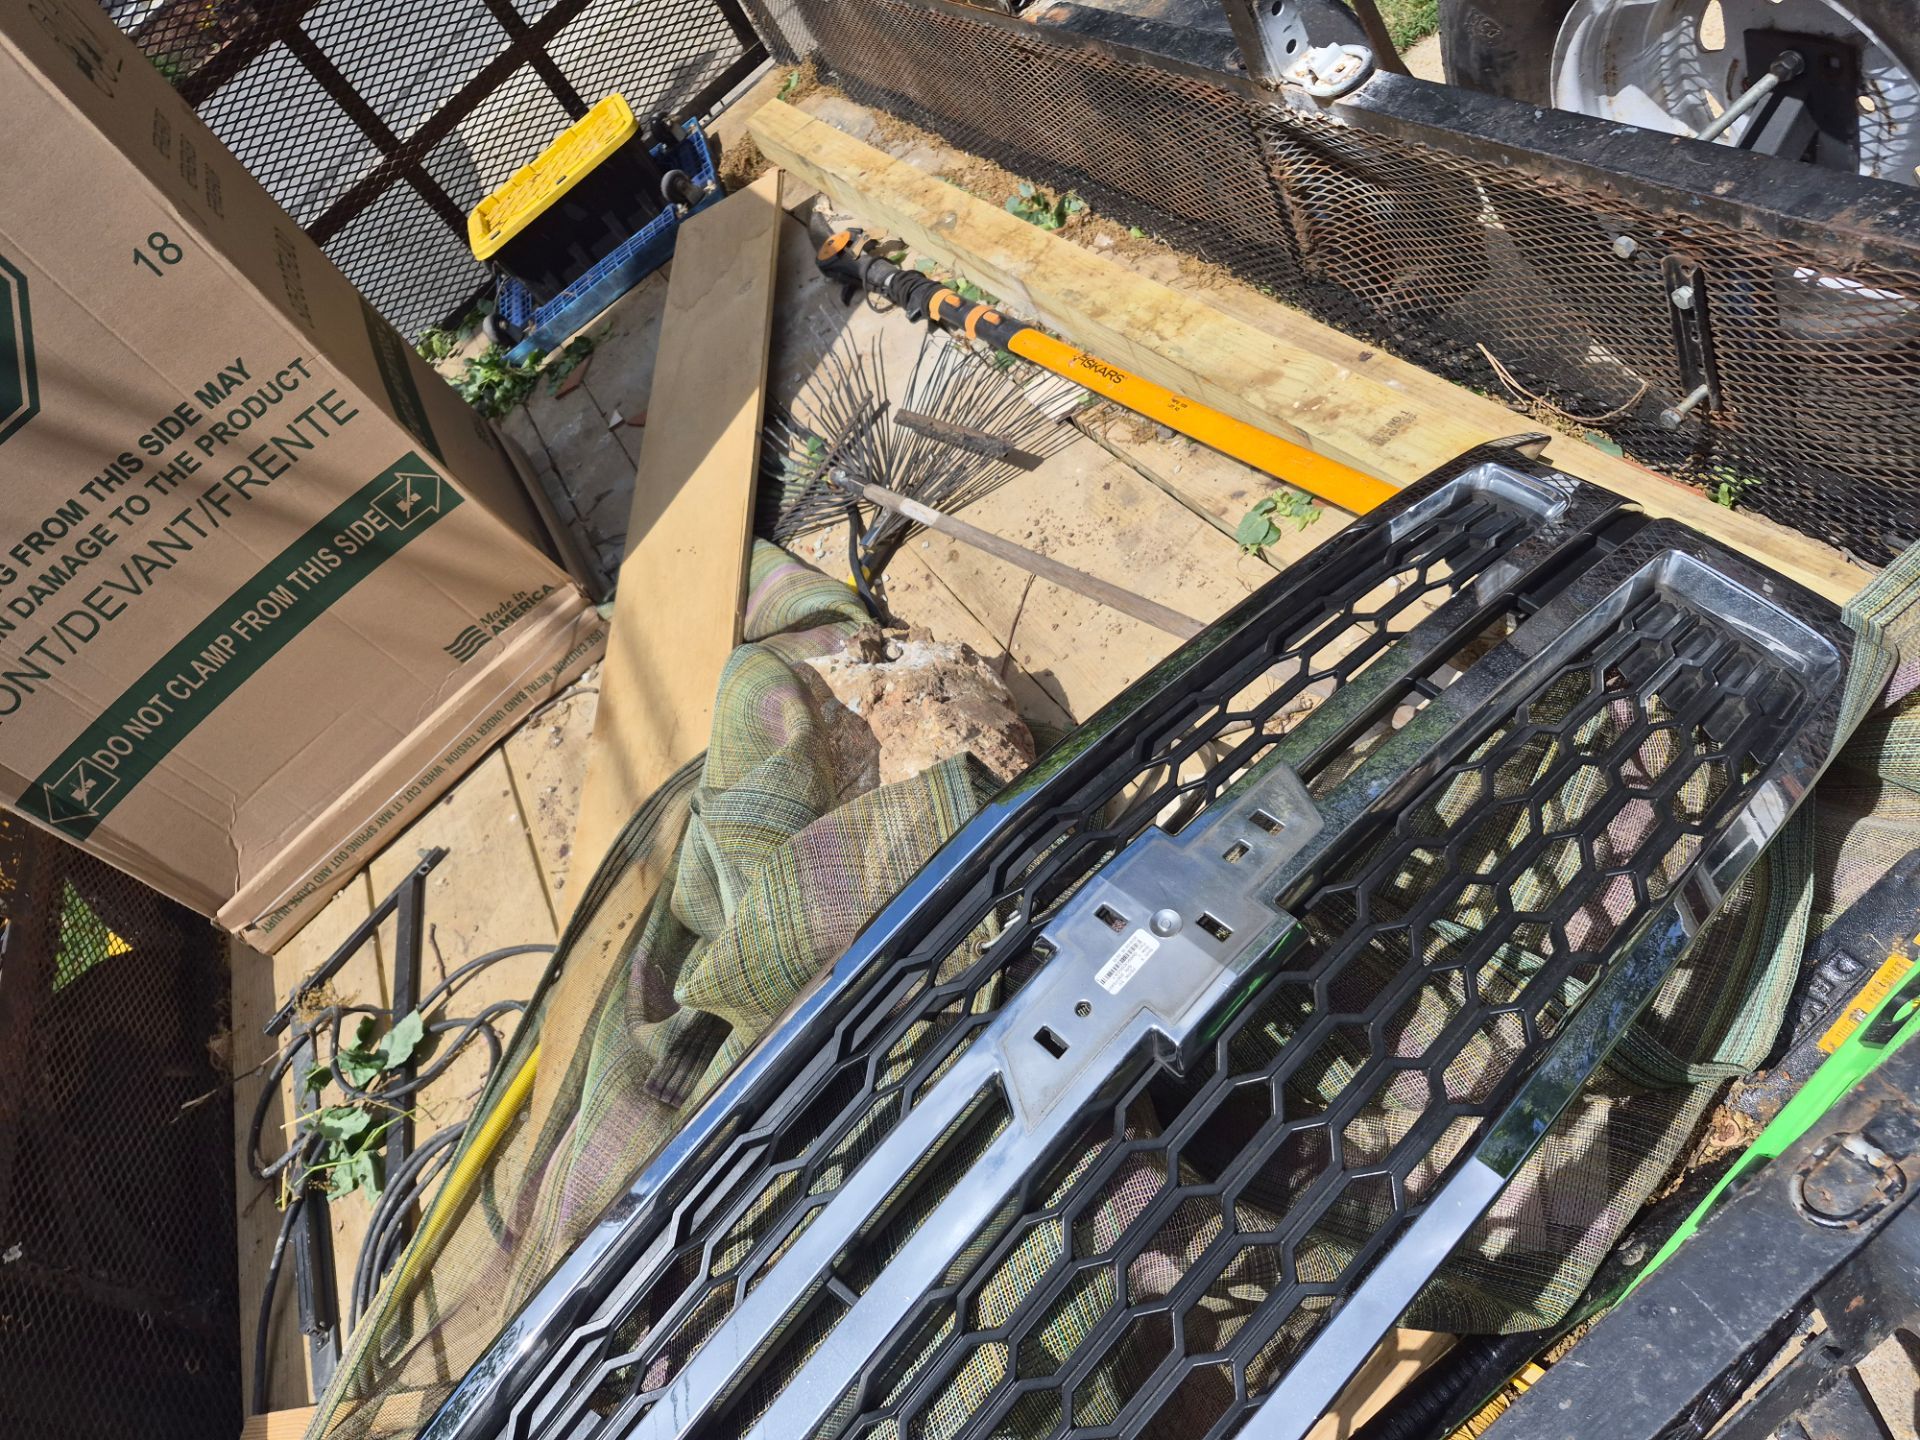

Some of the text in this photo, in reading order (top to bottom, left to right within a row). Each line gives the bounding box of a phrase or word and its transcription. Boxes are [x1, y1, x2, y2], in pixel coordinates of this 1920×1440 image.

[132, 231, 184, 278] 18
[8, 356, 252, 567] FROM THIS SIDE MAY
[7, 523, 119, 619] DAMAGE
[108, 494, 151, 527] TO
[143, 450, 203, 496] THE
[194, 357, 312, 457] PRODUCT
[0, 388, 360, 718] ONT/DEVANT/FRENTE
[479, 588, 528, 630] Made in
[491, 583, 555, 637] AMERICA
[91, 508, 391, 770] DO NOT CLAMP FROM THIS SIDE
[589, 629, 605, 648] USE
[525, 672, 554, 694] METAL
[503, 691, 528, 713] BAND
[477, 710, 507, 737] UNDER
[418, 764, 446, 789] WHEN
[392, 798, 404, 813] IT
[376, 808, 397, 831] MAY
[348, 825, 378, 853] SPRING
[332, 849, 349, 869] OUT
[313, 865, 333, 884] AND
[290, 880, 316, 904] CAUSE
